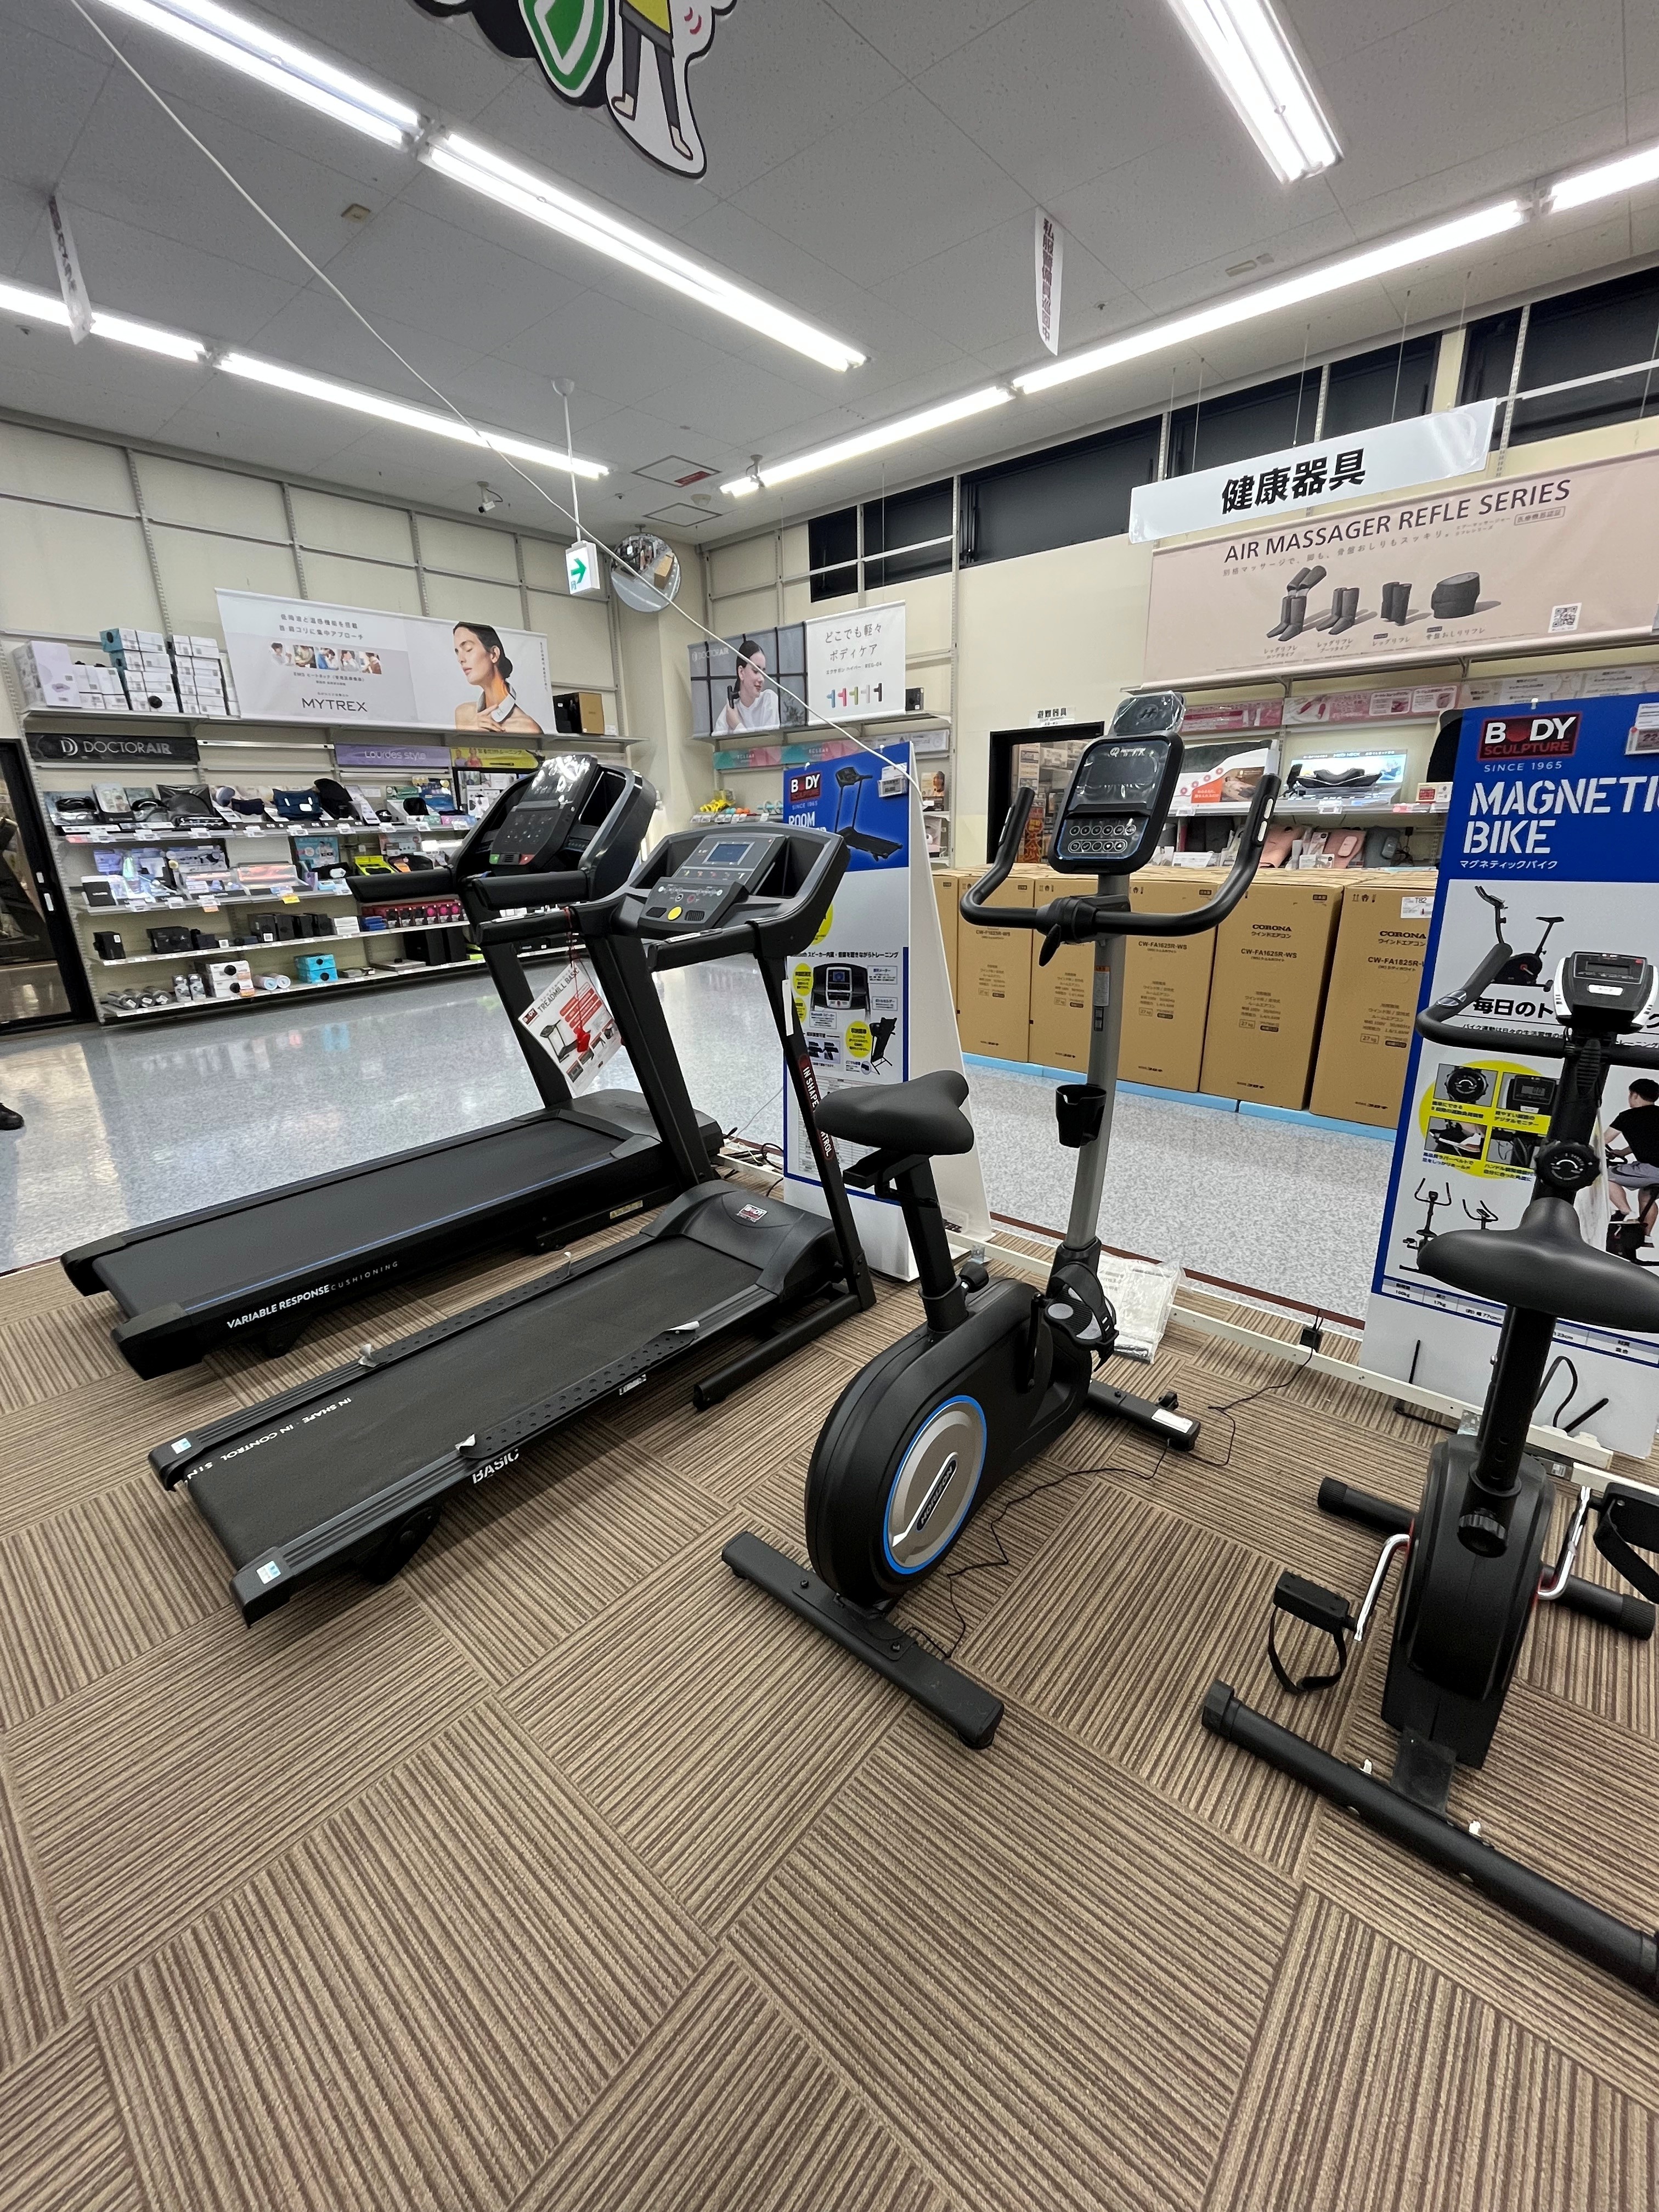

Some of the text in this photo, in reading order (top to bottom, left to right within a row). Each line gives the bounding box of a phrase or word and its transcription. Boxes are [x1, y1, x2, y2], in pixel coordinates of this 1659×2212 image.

[1222, 448, 1366, 515] 健康器具
[1224, 479, 1571, 563] AIR MASSAGER REFLE SERIES
[825, 624, 882, 643] どこでも軽々
[830, 644, 877, 661] ボディケア
[302, 698, 368, 712] MYTREX
[83, 741, 173, 754] DOCTORAIR
[1484, 741, 1570, 755] SCULPTURE
[1483, 761, 1562, 772] SINCE 1965
[1469, 775, 1659, 816] MAGNETI
[788, 811, 815, 827] ROOM
[1463, 820, 1556, 854] BIKE
[1460, 860, 1558, 870] マグネティックバイク
[1241, 948, 1297, 958] CW-FA1625R-WS
[1368, 957, 1424, 967] CW-FA1825R-
[538, 983, 567, 1013] TREADMILL
[1473, 997, 1554, 1018] 毎日のト
[803, 1066, 811, 1079] IN
[806, 1077, 820, 1108] SHAPE
[227, 1261, 398, 1328] VARIABLE RESPONSE CUSHIONING
[220, 1397, 352, 1461] IN SHAPE IN CONTROL
[472, 1448, 519, 1484] BASIC
[921, 1466, 952, 1525] HORIZON
